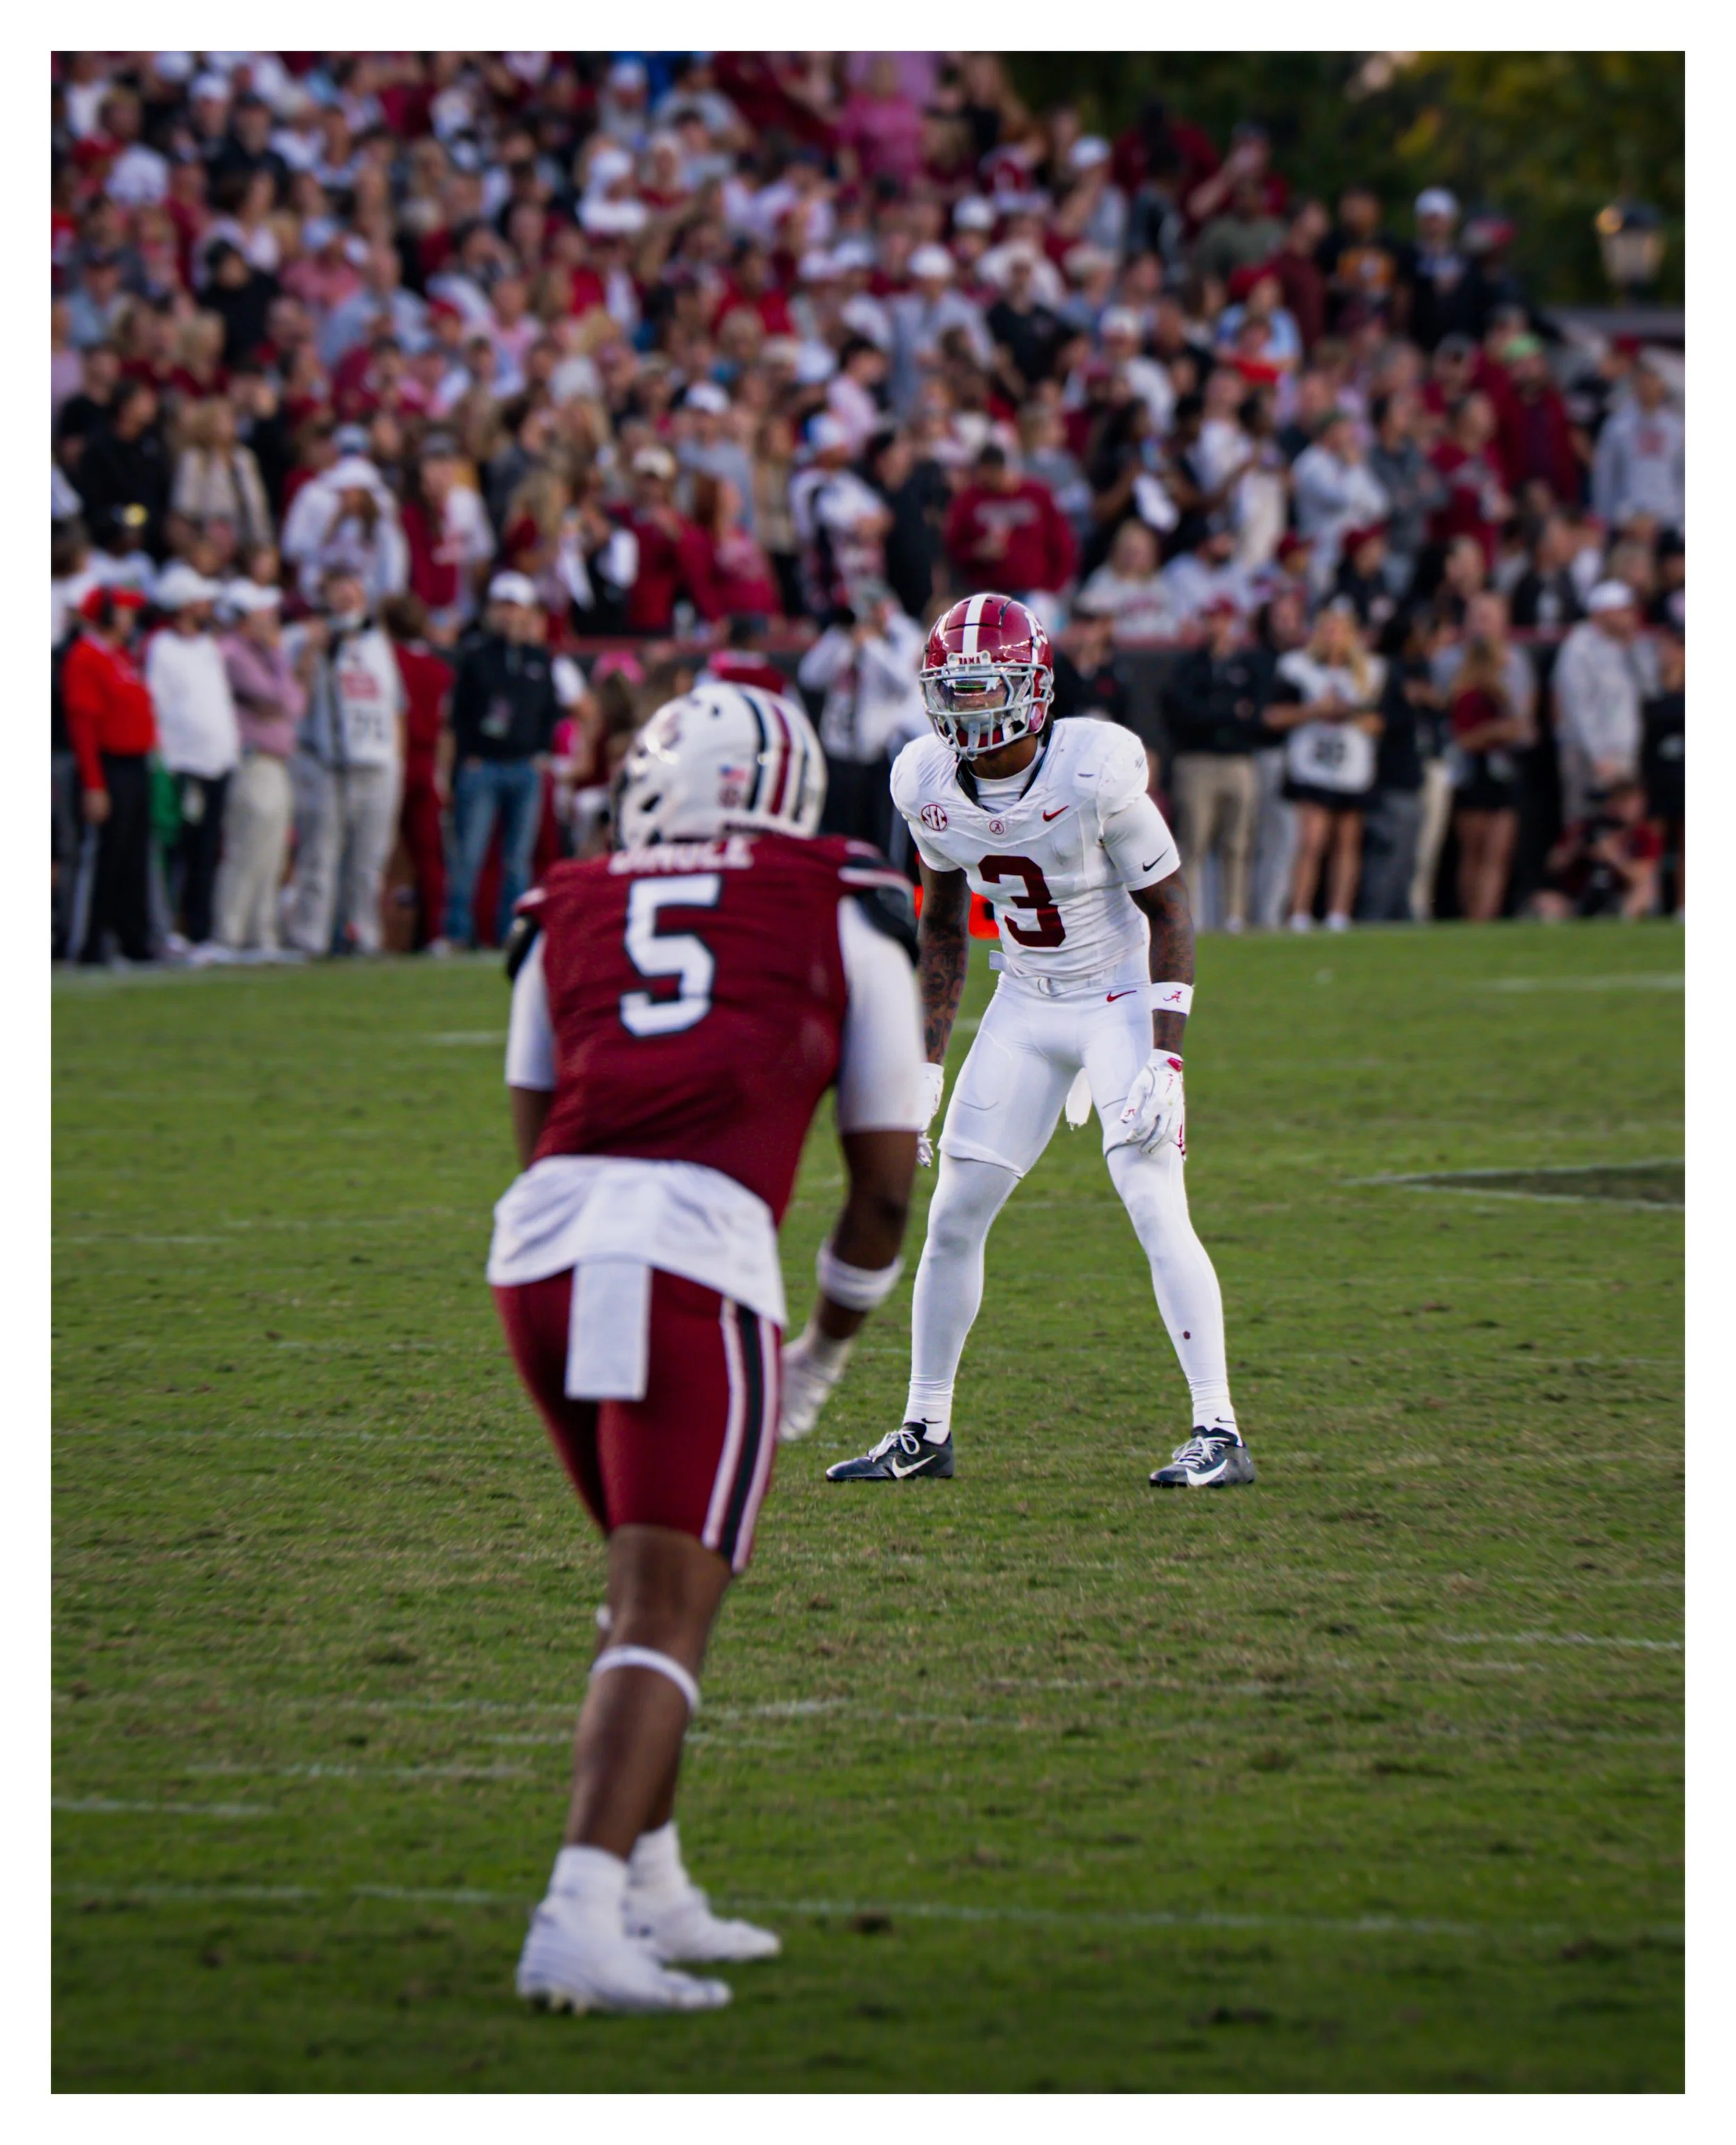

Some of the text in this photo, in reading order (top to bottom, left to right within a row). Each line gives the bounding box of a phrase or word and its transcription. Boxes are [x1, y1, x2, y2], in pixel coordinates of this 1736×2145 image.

[921, 806, 947, 831] SEC
[977, 855, 1066, 947] 3
[620, 874, 719, 1037] 5
